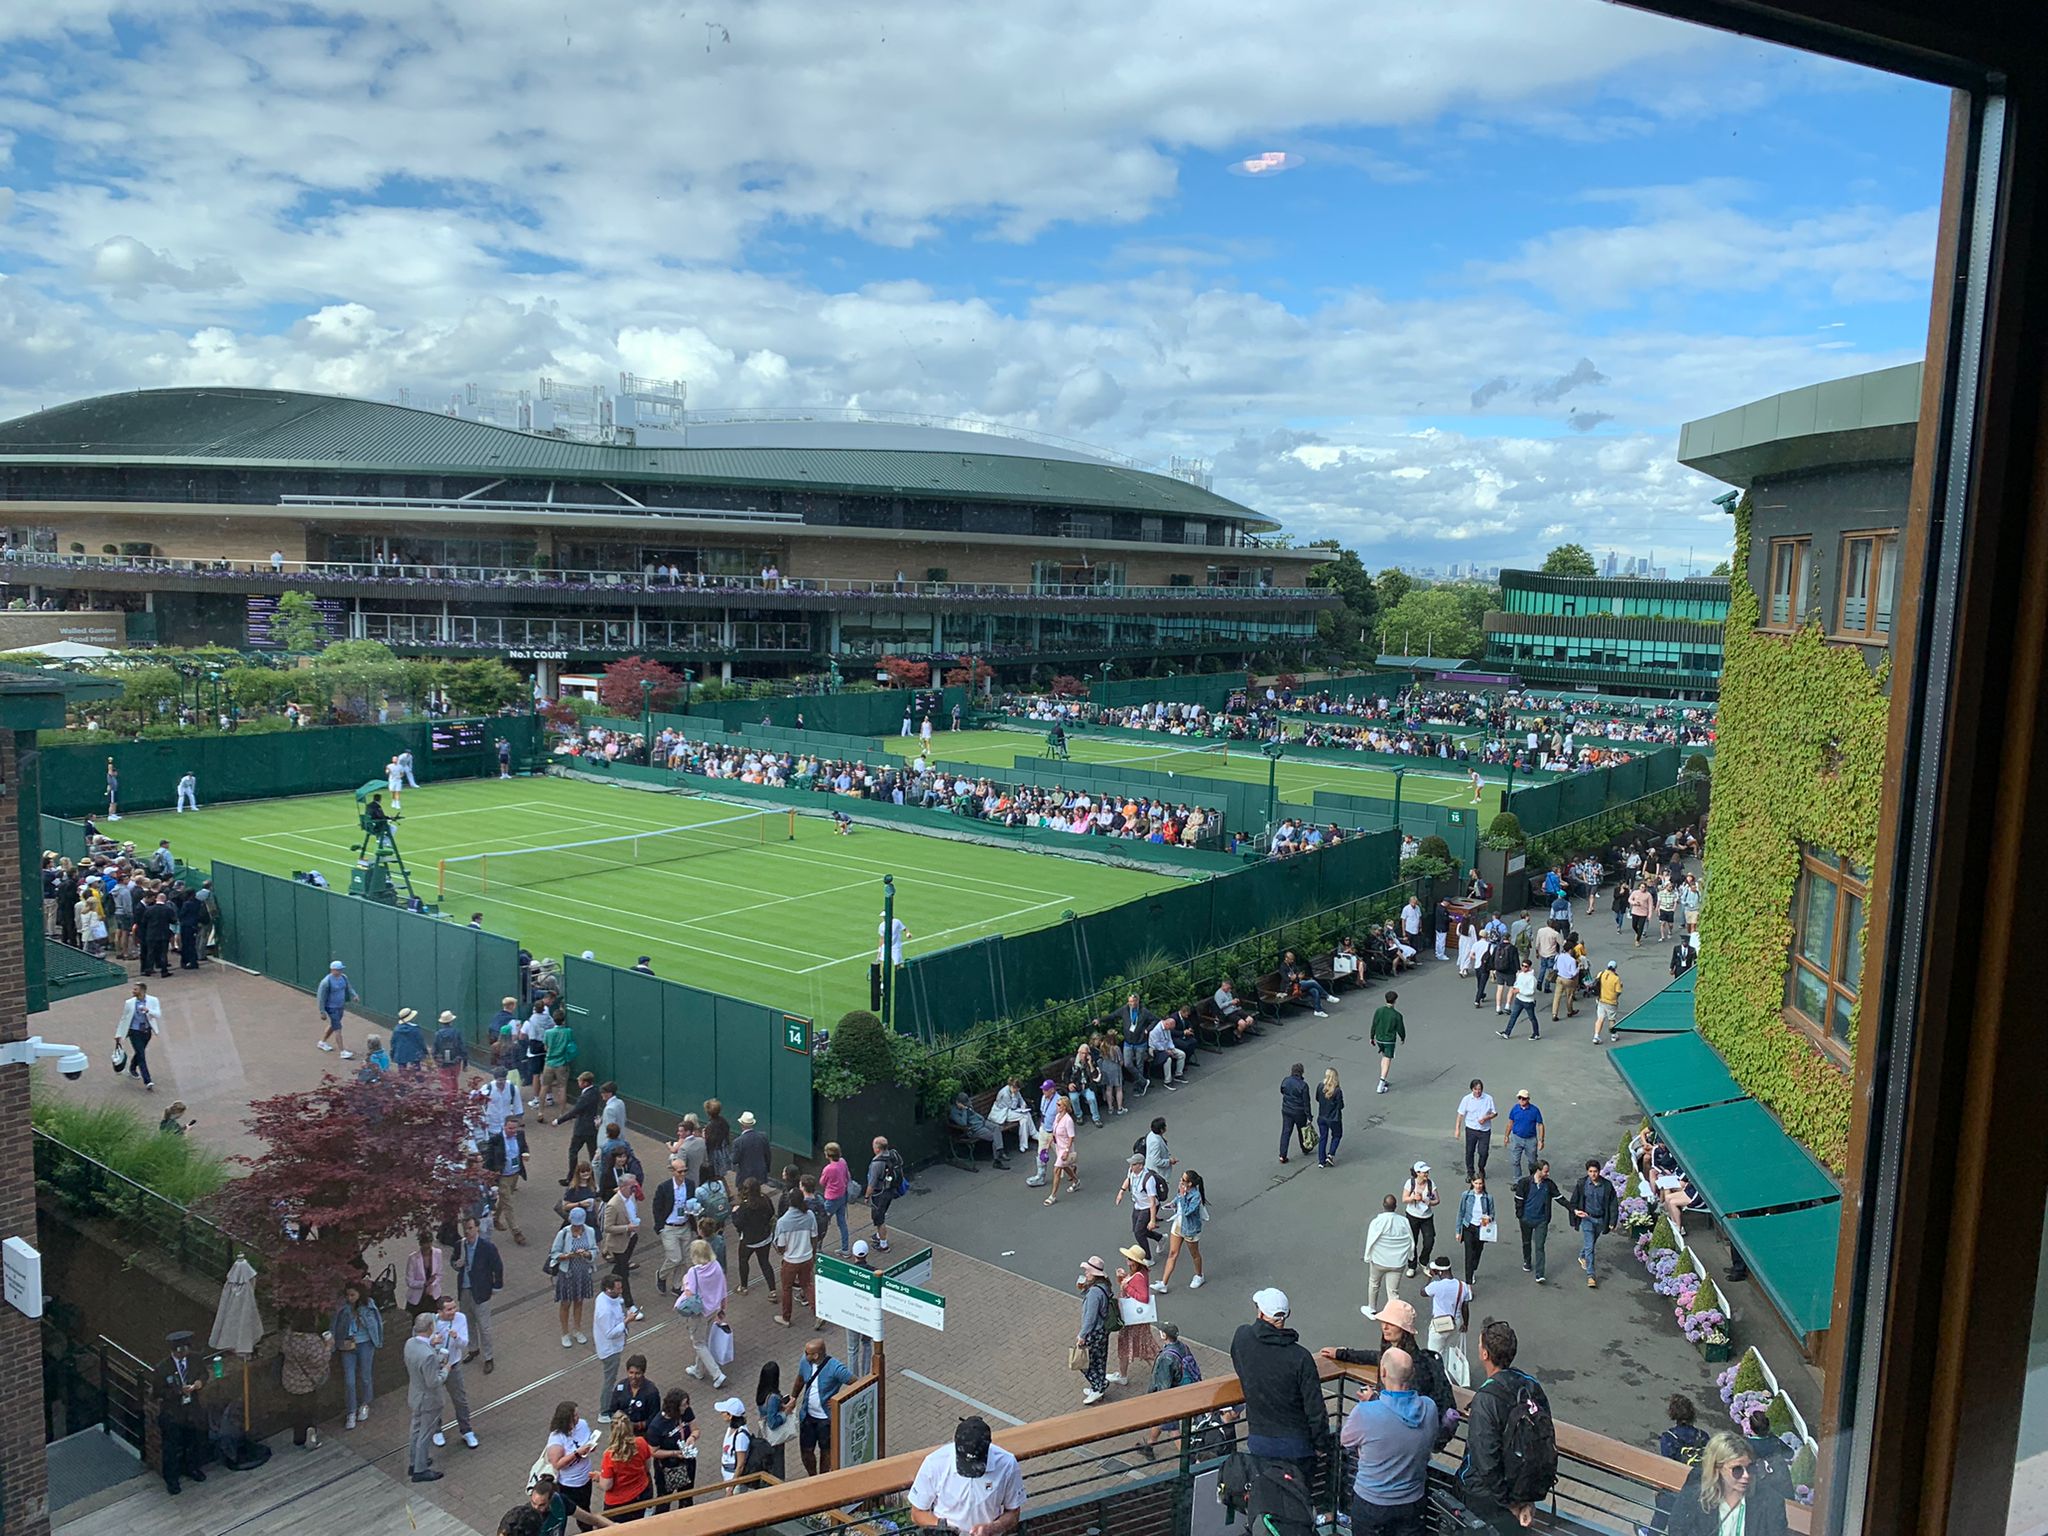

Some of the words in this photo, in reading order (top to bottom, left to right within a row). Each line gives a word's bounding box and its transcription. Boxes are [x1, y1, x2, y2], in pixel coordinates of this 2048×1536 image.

[509, 650, 531, 659] No.1
[532, 650, 569, 659] COURT
[1451, 814, 1460, 822] 15
[789, 1030, 802, 1044] 14
[858, 1271, 871, 1280] Court
[852, 1280, 865, 1289] Court
